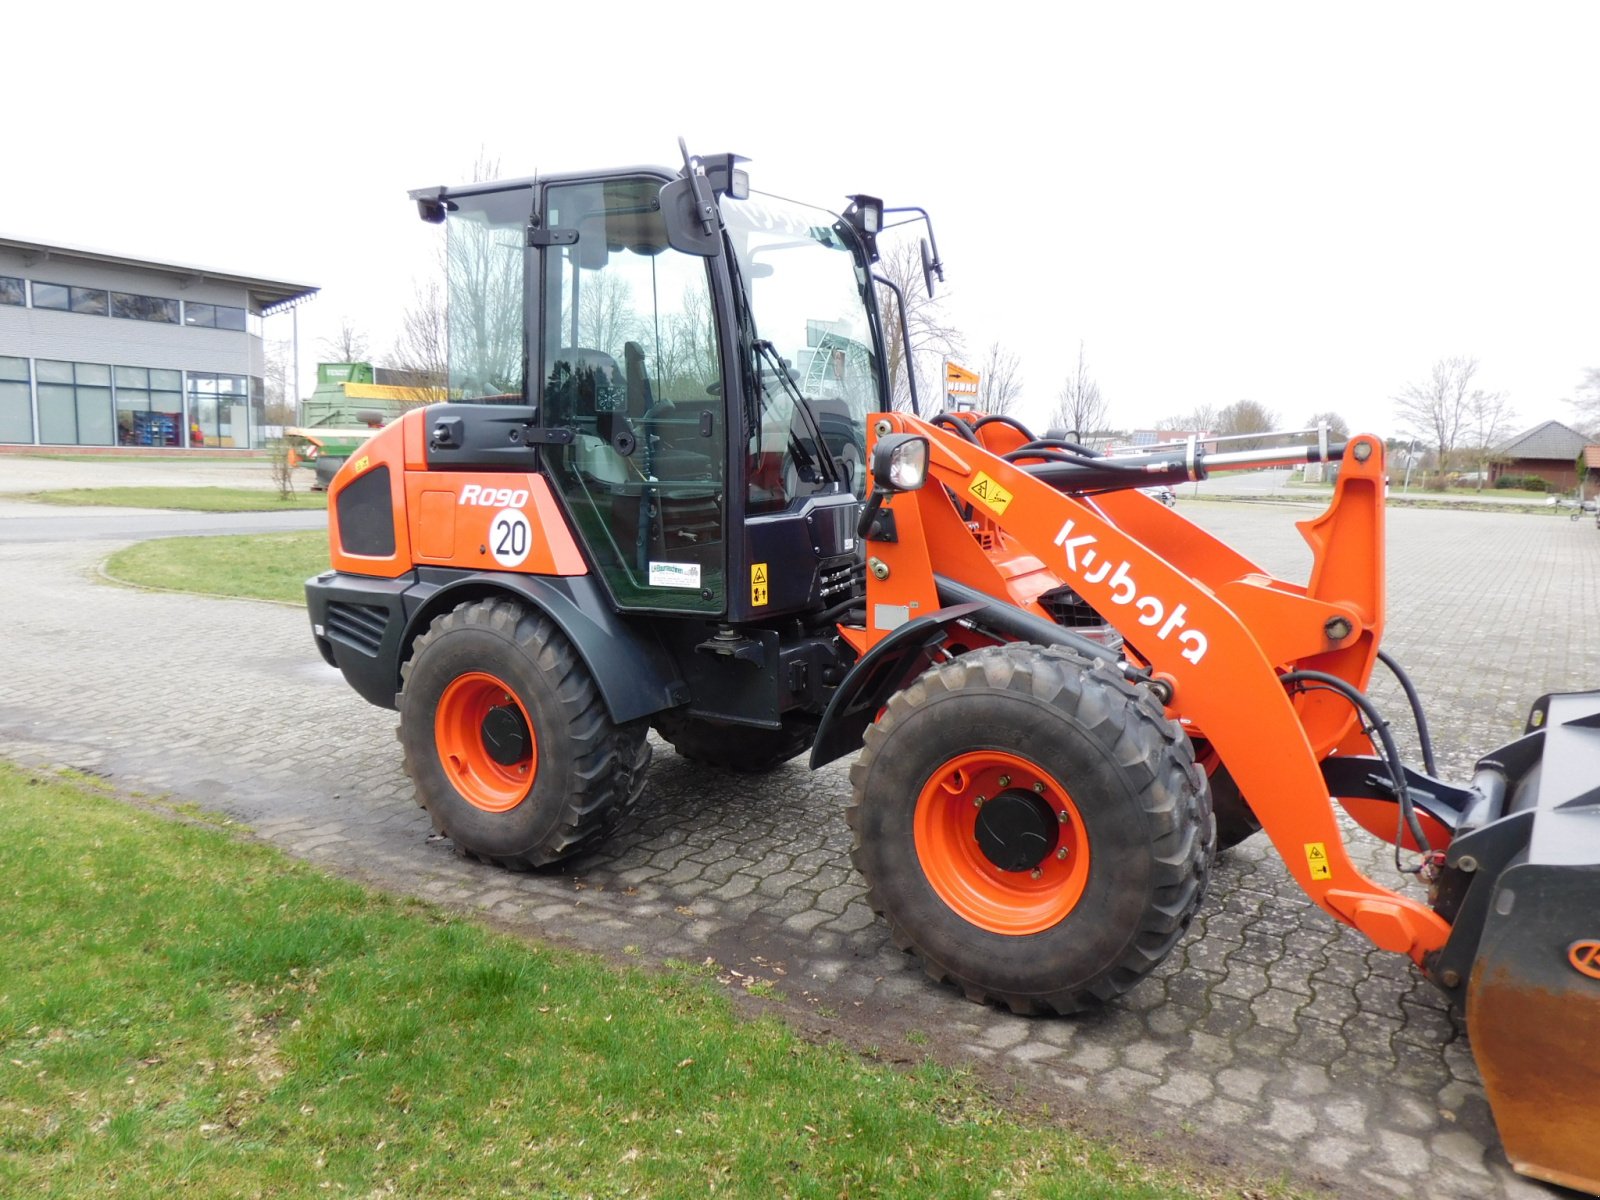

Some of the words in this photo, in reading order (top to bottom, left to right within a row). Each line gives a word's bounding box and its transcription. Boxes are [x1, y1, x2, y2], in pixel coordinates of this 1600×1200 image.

[459, 484, 529, 508] R090
[496, 520, 526, 556] 20
[1053, 518, 1208, 666] Kubota
